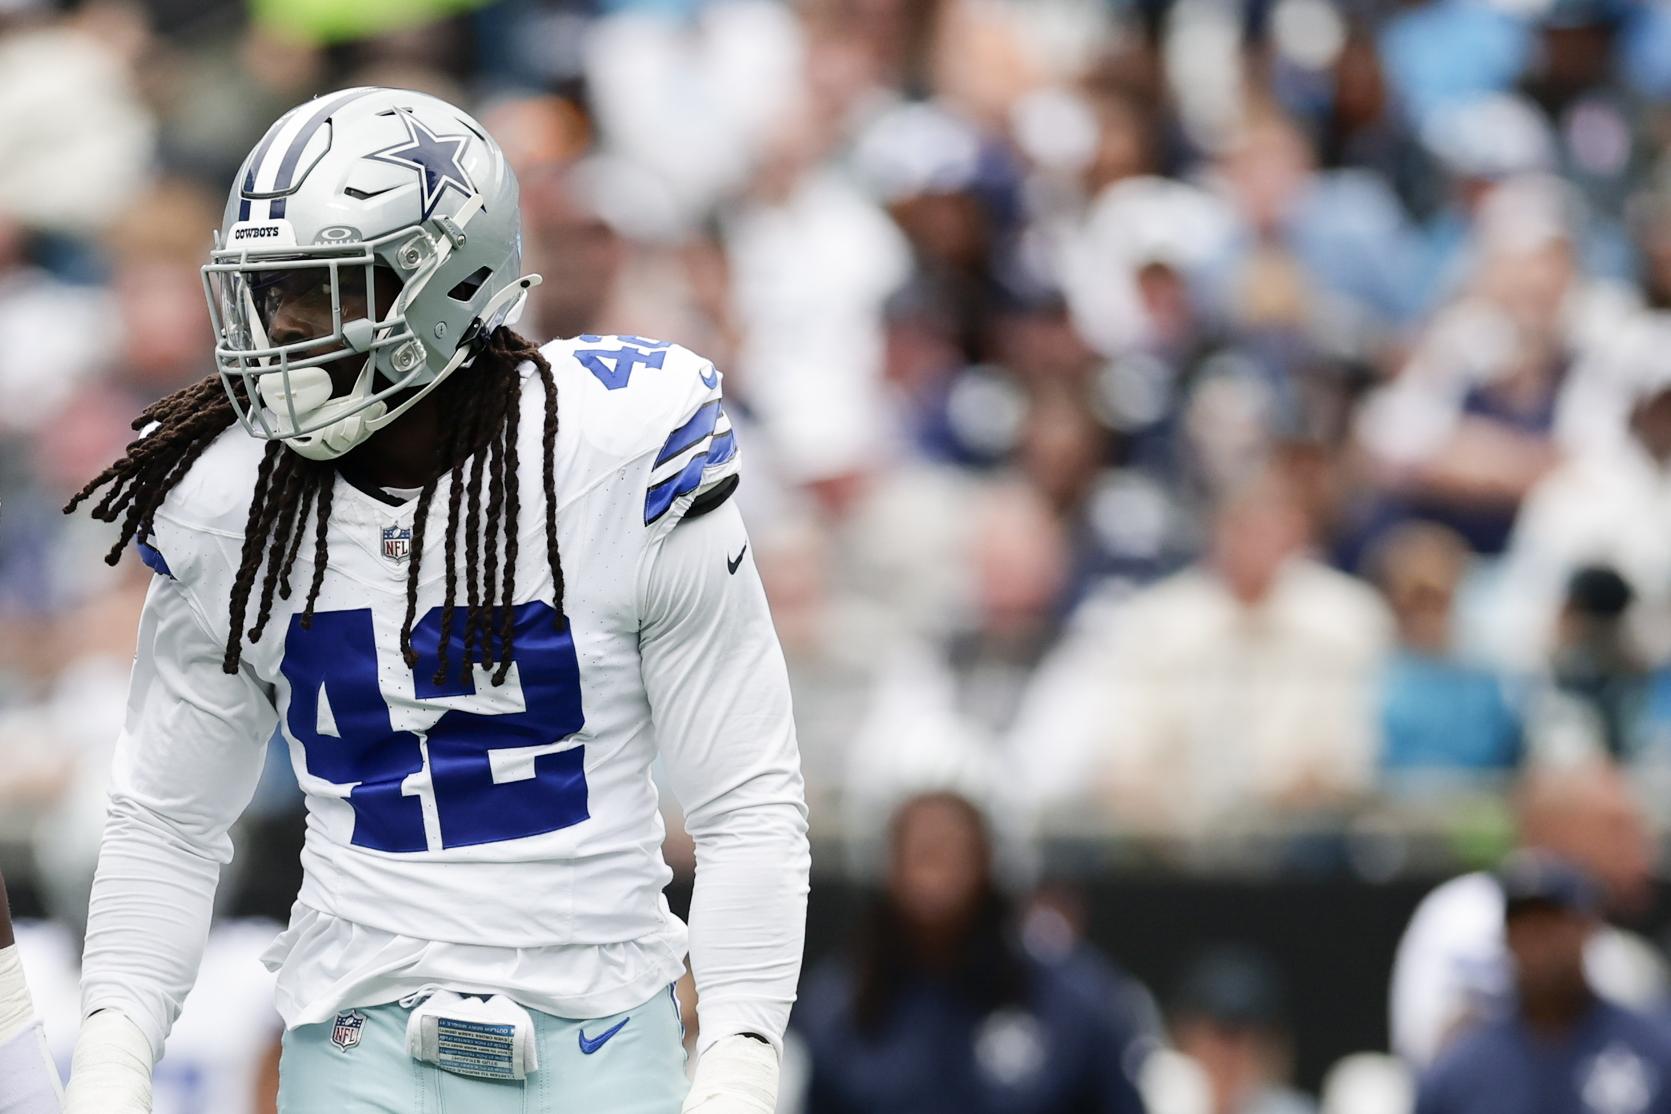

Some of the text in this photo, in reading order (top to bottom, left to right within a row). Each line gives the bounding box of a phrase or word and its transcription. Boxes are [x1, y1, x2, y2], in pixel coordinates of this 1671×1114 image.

[235, 226, 279, 240] COWBOYS
[385, 540, 408, 557] NFL
[279, 599, 591, 853] 42
[334, 1026, 355, 1044] NFL
